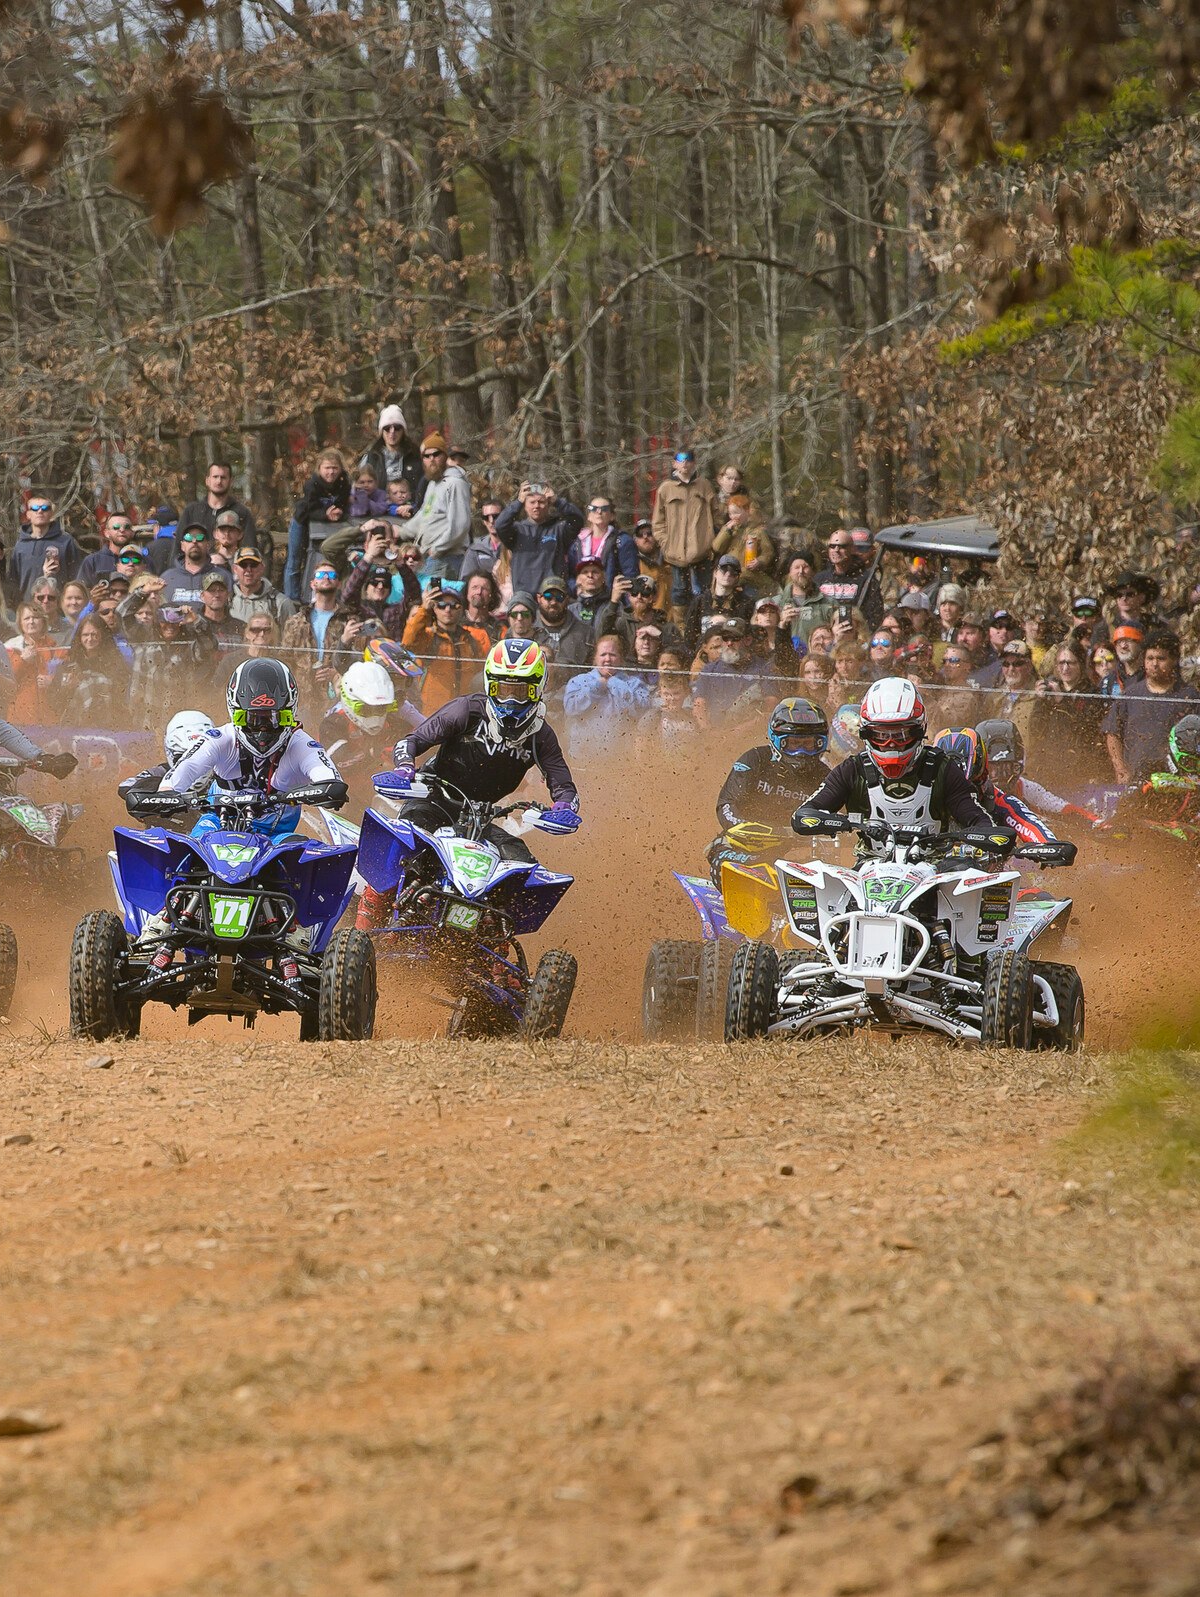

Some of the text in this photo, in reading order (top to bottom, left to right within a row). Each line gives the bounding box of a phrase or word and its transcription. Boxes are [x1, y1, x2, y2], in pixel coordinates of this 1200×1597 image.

[141, 797, 180, 805] ACERBIS
[286, 788, 324, 799] ACERBIS
[757, 779, 811, 803] Fly Racin
[1019, 847, 1057, 855] ACERBIS
[456, 855, 492, 876] 192
[213, 900, 249, 927] 171
[446, 903, 480, 929] 192
